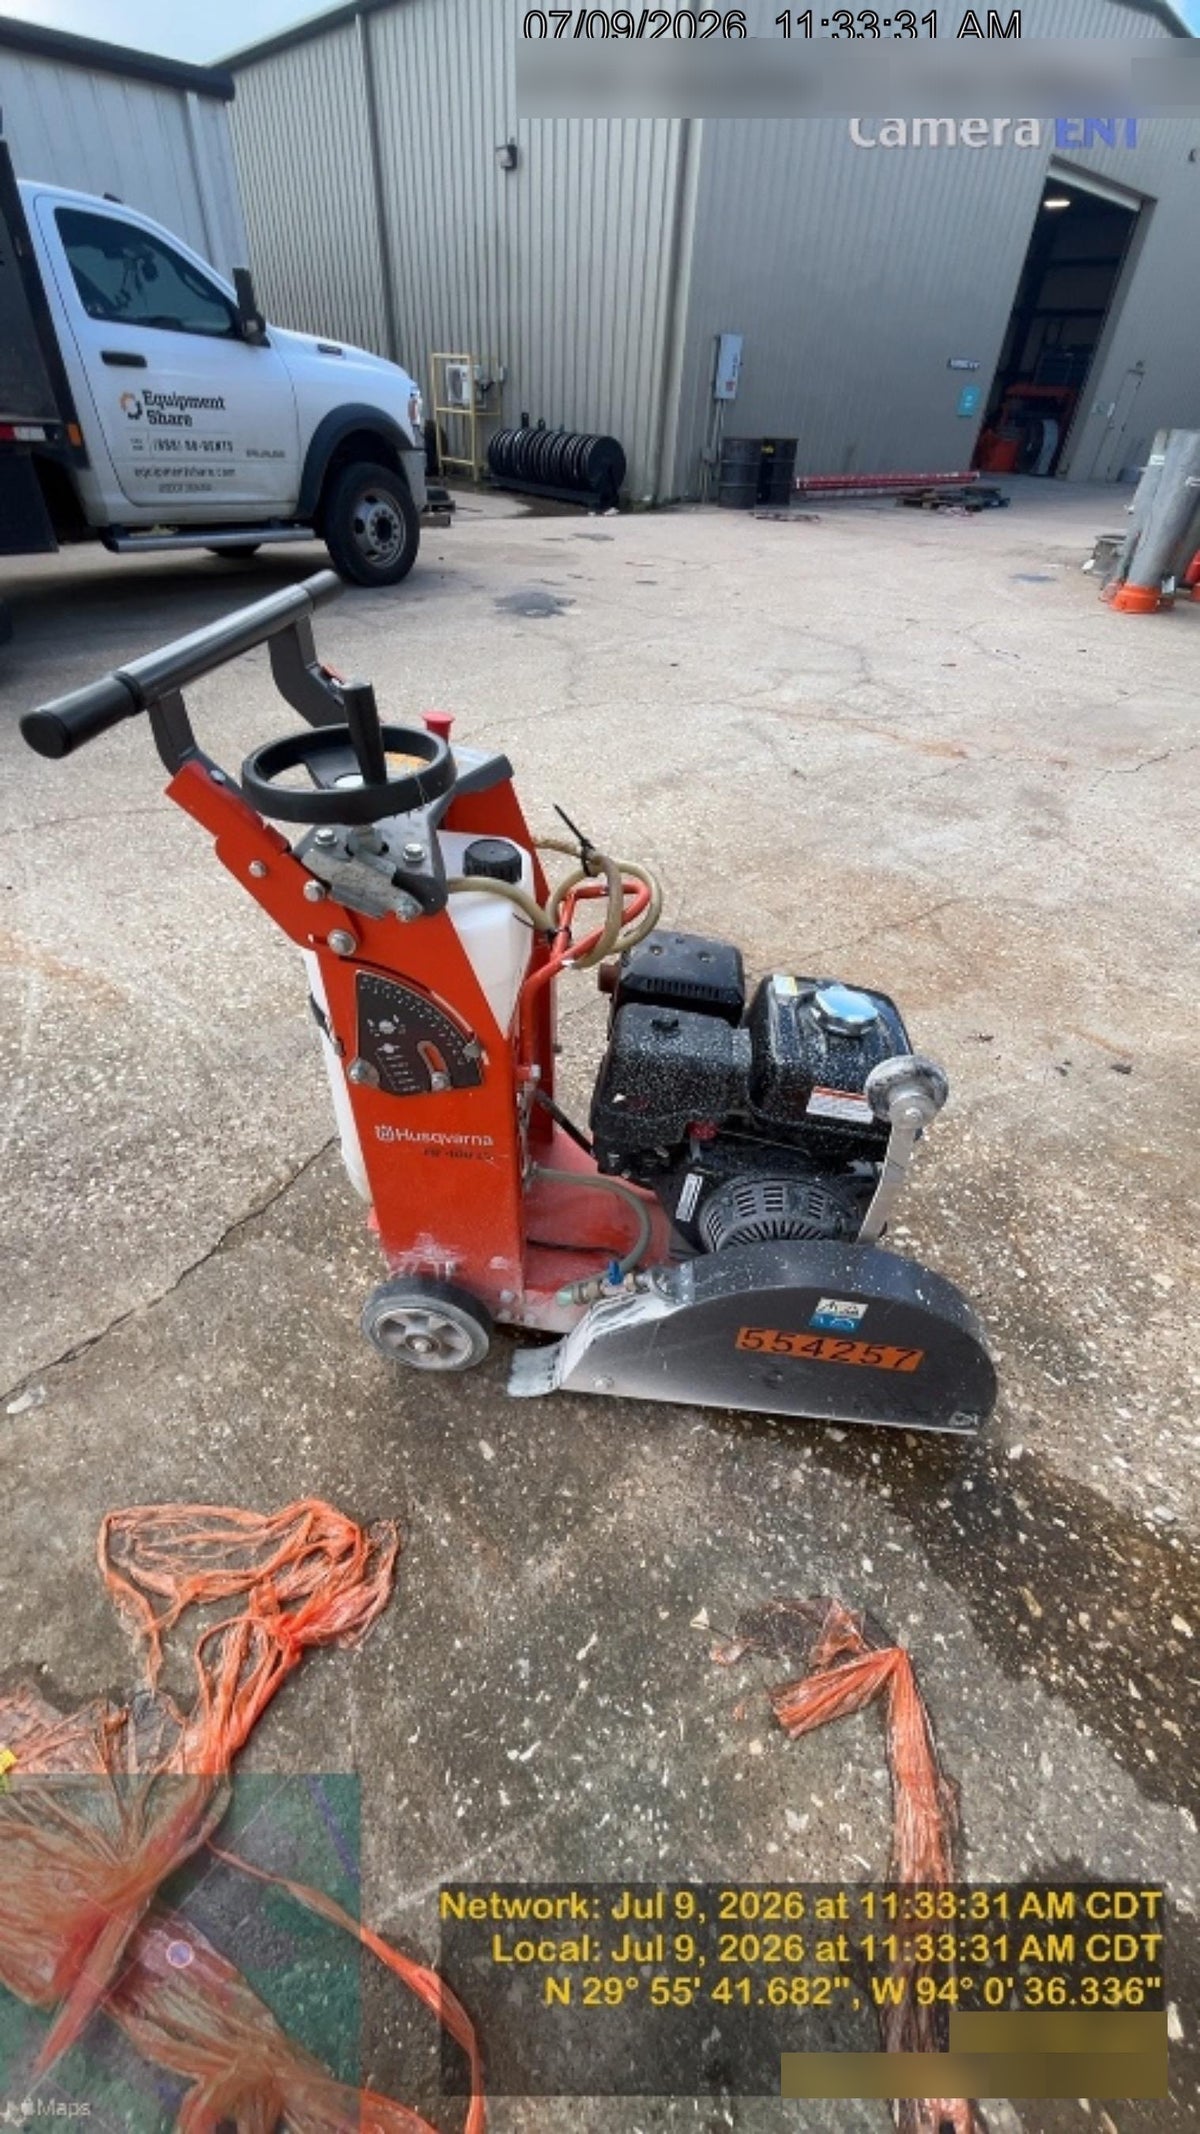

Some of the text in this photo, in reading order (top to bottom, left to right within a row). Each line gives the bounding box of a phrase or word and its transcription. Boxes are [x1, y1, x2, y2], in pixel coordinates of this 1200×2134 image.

[142, 389, 226, 412] Equipment
[147, 410, 193, 428] Share
[395, 1127, 494, 1147] Husqvarna
[741, 1329, 917, 1369] 554257
